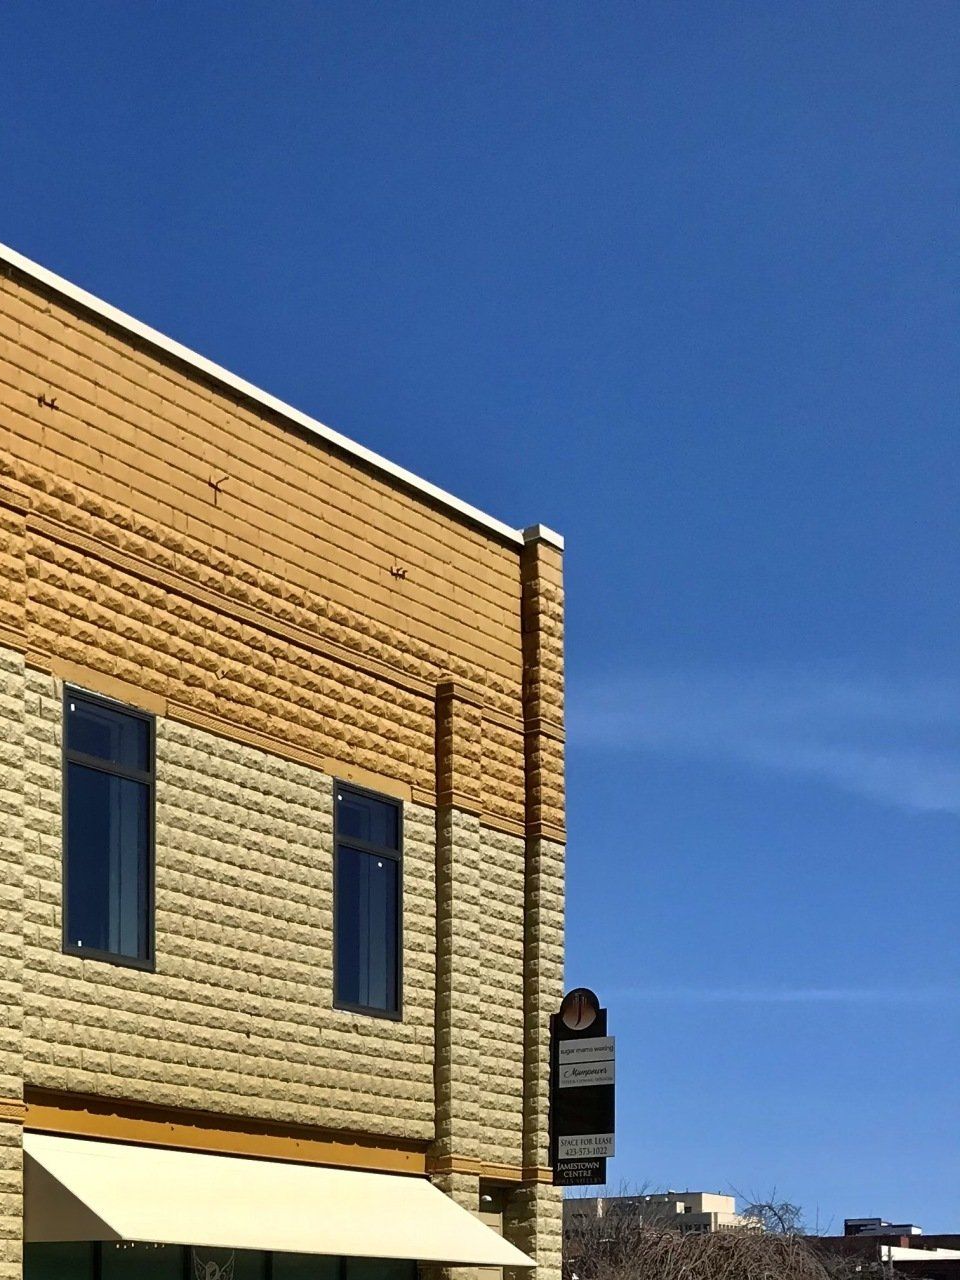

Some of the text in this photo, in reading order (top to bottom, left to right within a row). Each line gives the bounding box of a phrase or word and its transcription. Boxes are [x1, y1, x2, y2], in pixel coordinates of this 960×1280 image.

[594, 1137, 613, 1145] LEASE
[565, 1147, 608, 1156] 423-573-1022
[557, 1161, 600, 1172] JAMESTOWN
[563, 1169, 592, 1178] CENTRE
